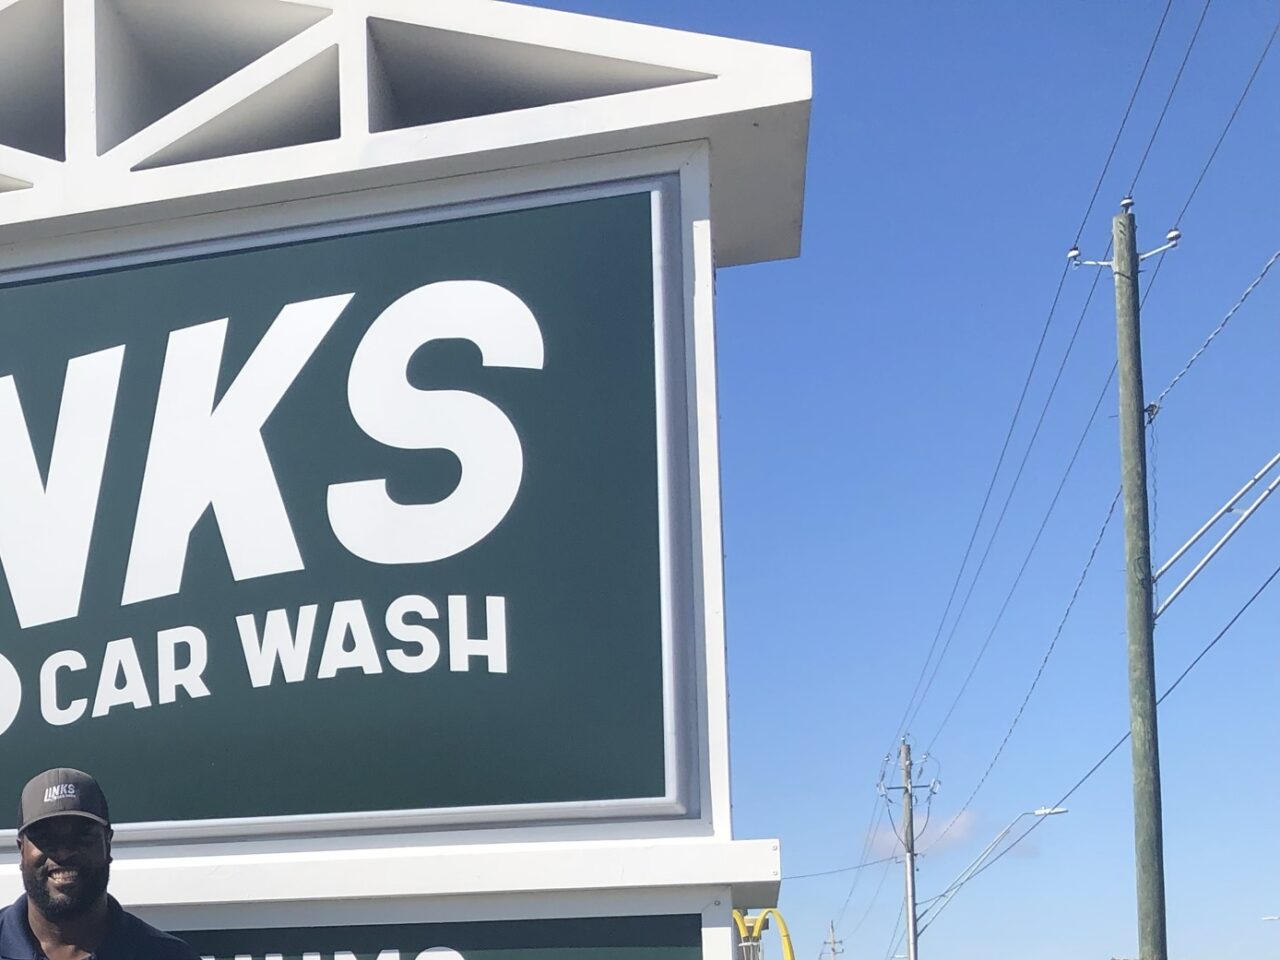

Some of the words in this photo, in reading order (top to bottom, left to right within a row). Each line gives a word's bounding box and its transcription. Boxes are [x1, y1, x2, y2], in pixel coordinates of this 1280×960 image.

[39, 626, 211, 726] CAR
[236, 594, 509, 687] WASH
[43, 783, 76, 803] LINKS
